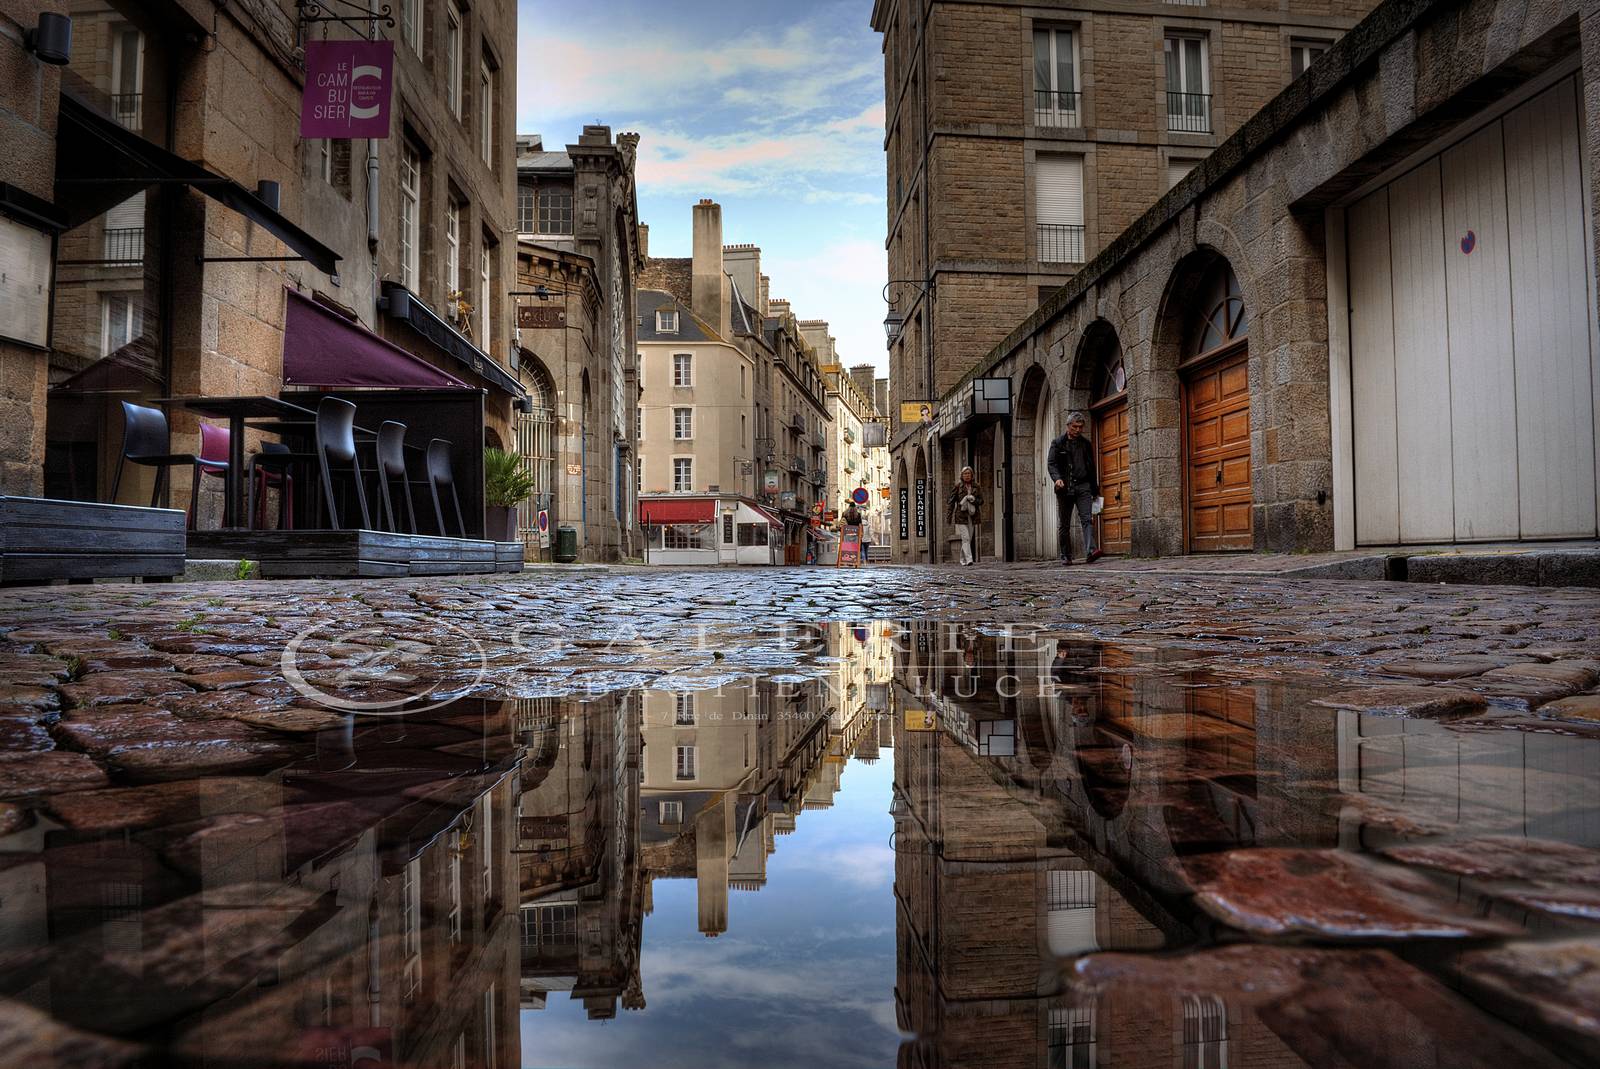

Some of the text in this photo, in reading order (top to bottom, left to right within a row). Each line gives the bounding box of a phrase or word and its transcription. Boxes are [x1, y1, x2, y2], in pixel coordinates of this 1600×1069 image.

[337, 62, 347, 71] LE
[317, 72, 348, 87] CAM
[328, 89, 347, 103] BU
[314, 104, 345, 119] SIER
